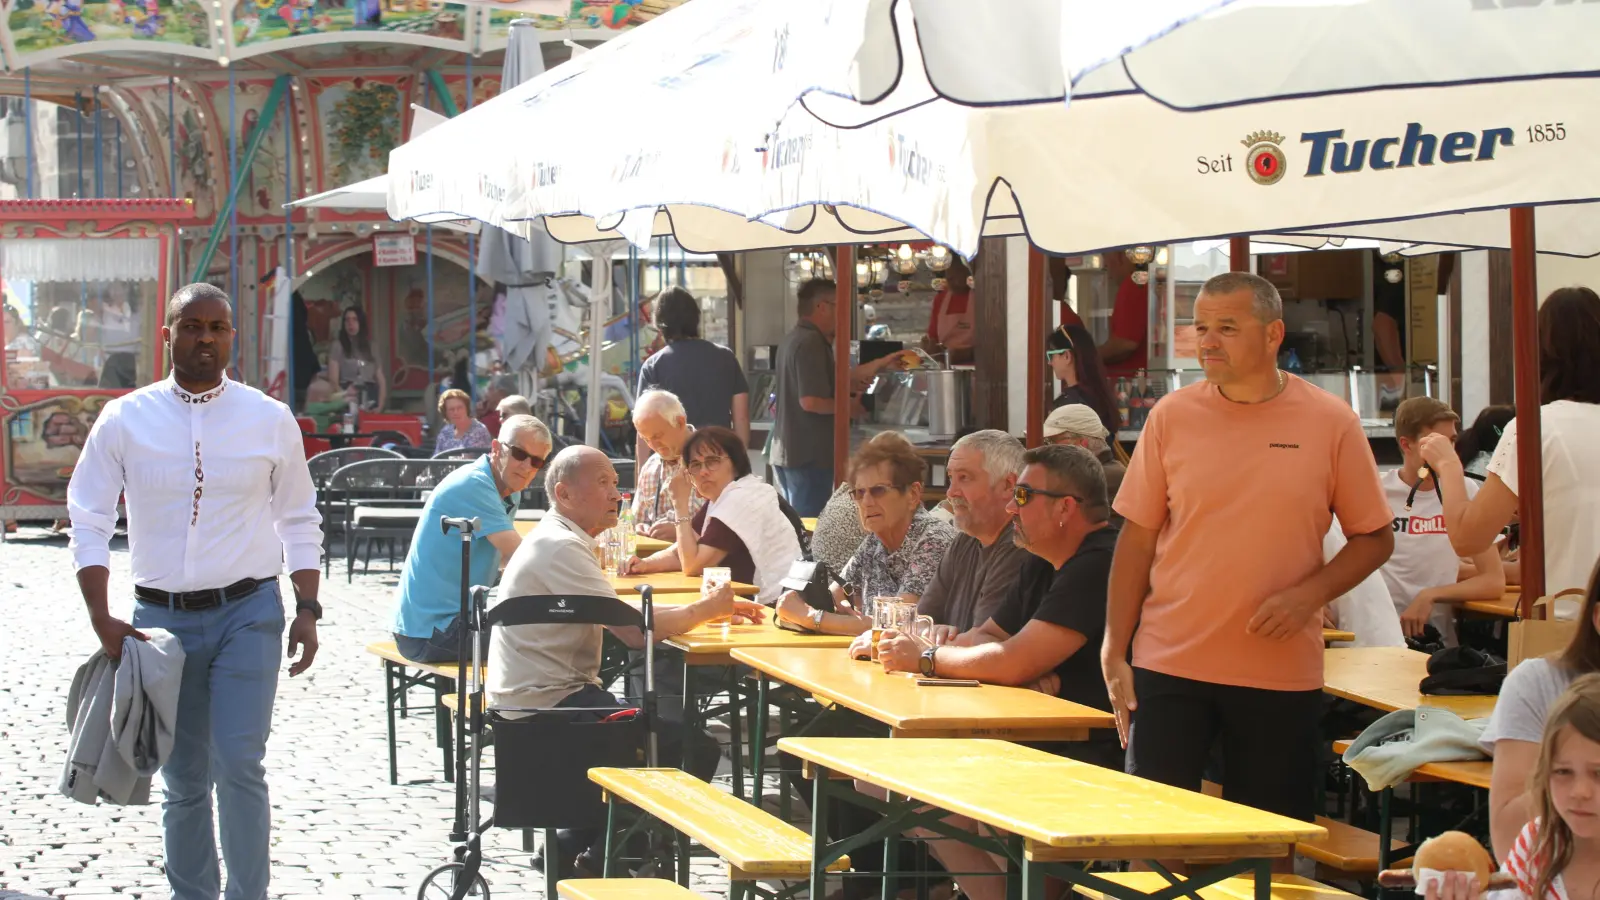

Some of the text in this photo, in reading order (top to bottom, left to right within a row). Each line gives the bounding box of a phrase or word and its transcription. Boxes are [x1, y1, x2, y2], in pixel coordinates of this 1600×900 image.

[1197, 154, 1233, 175] Seit
[1300, 122, 1515, 178] Tucher
[1526, 122, 1567, 144] 1855
[1391, 516, 1409, 533] ST
